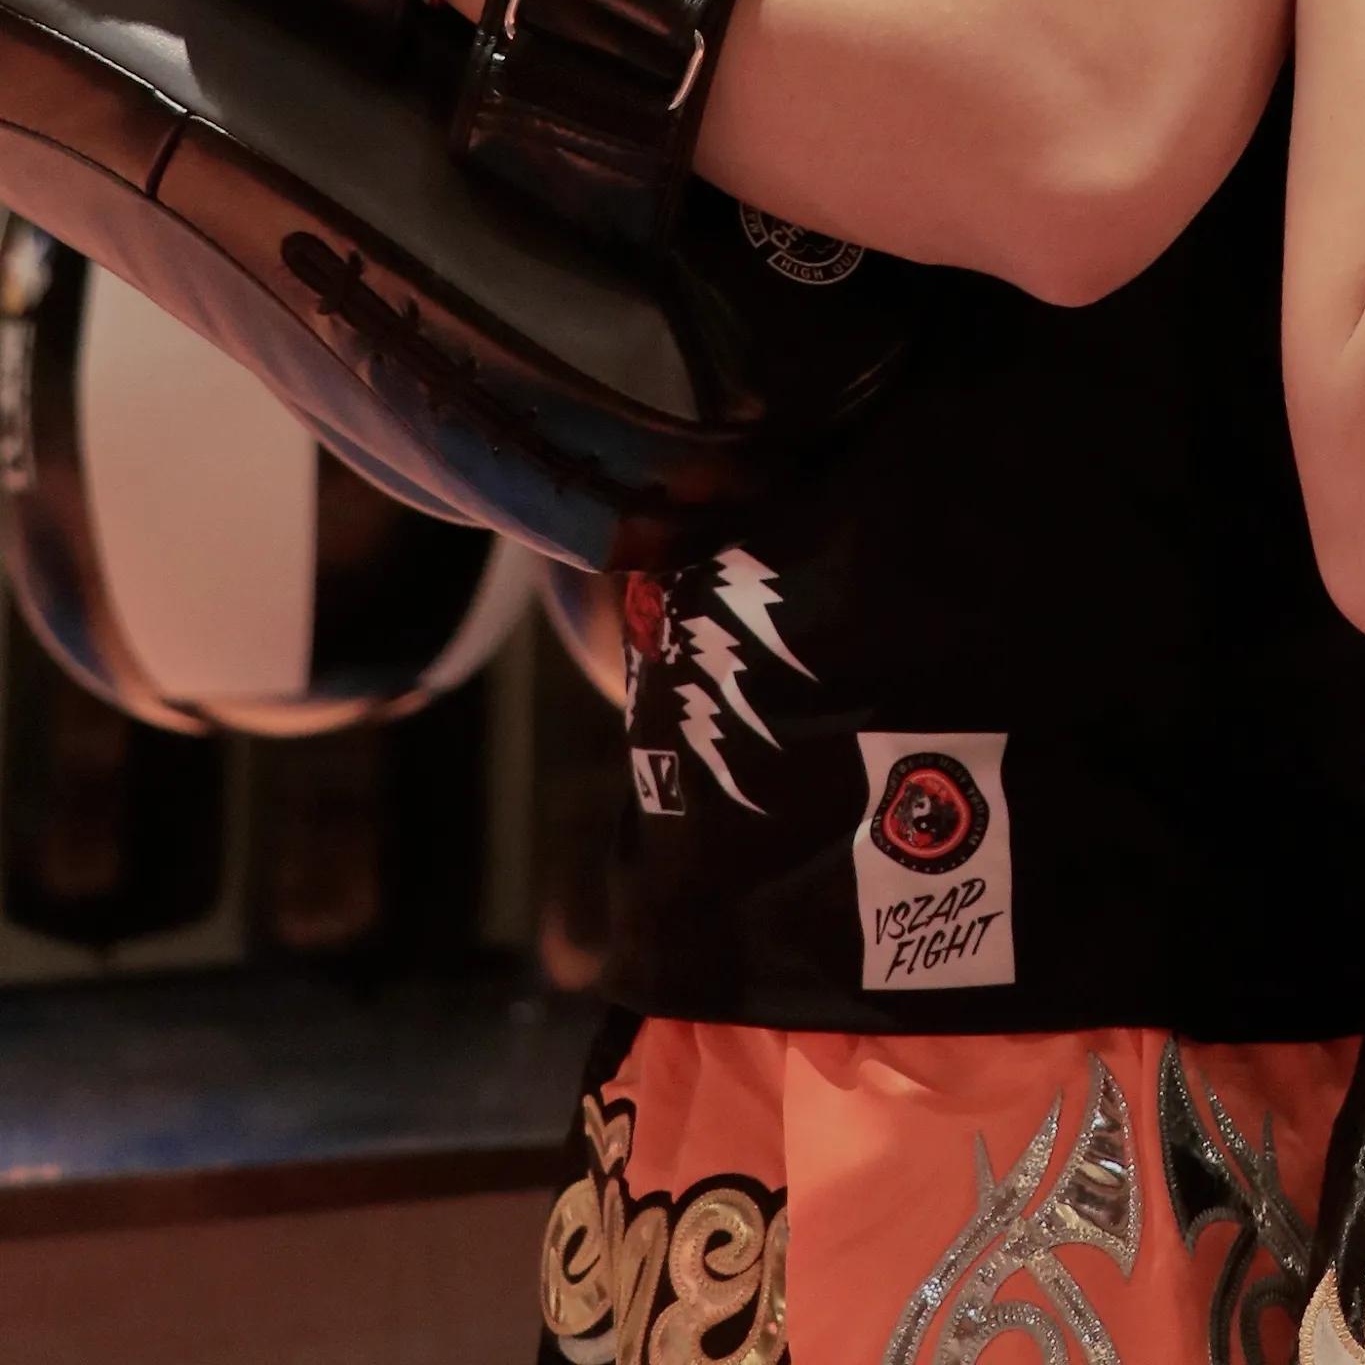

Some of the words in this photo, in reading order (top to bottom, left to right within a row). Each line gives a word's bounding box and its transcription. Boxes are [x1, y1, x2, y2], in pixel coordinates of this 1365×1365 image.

[779, 258, 825, 280] HIGH
[875, 877, 987, 946] VSZAP
[884, 910, 1005, 983] FIGHT
